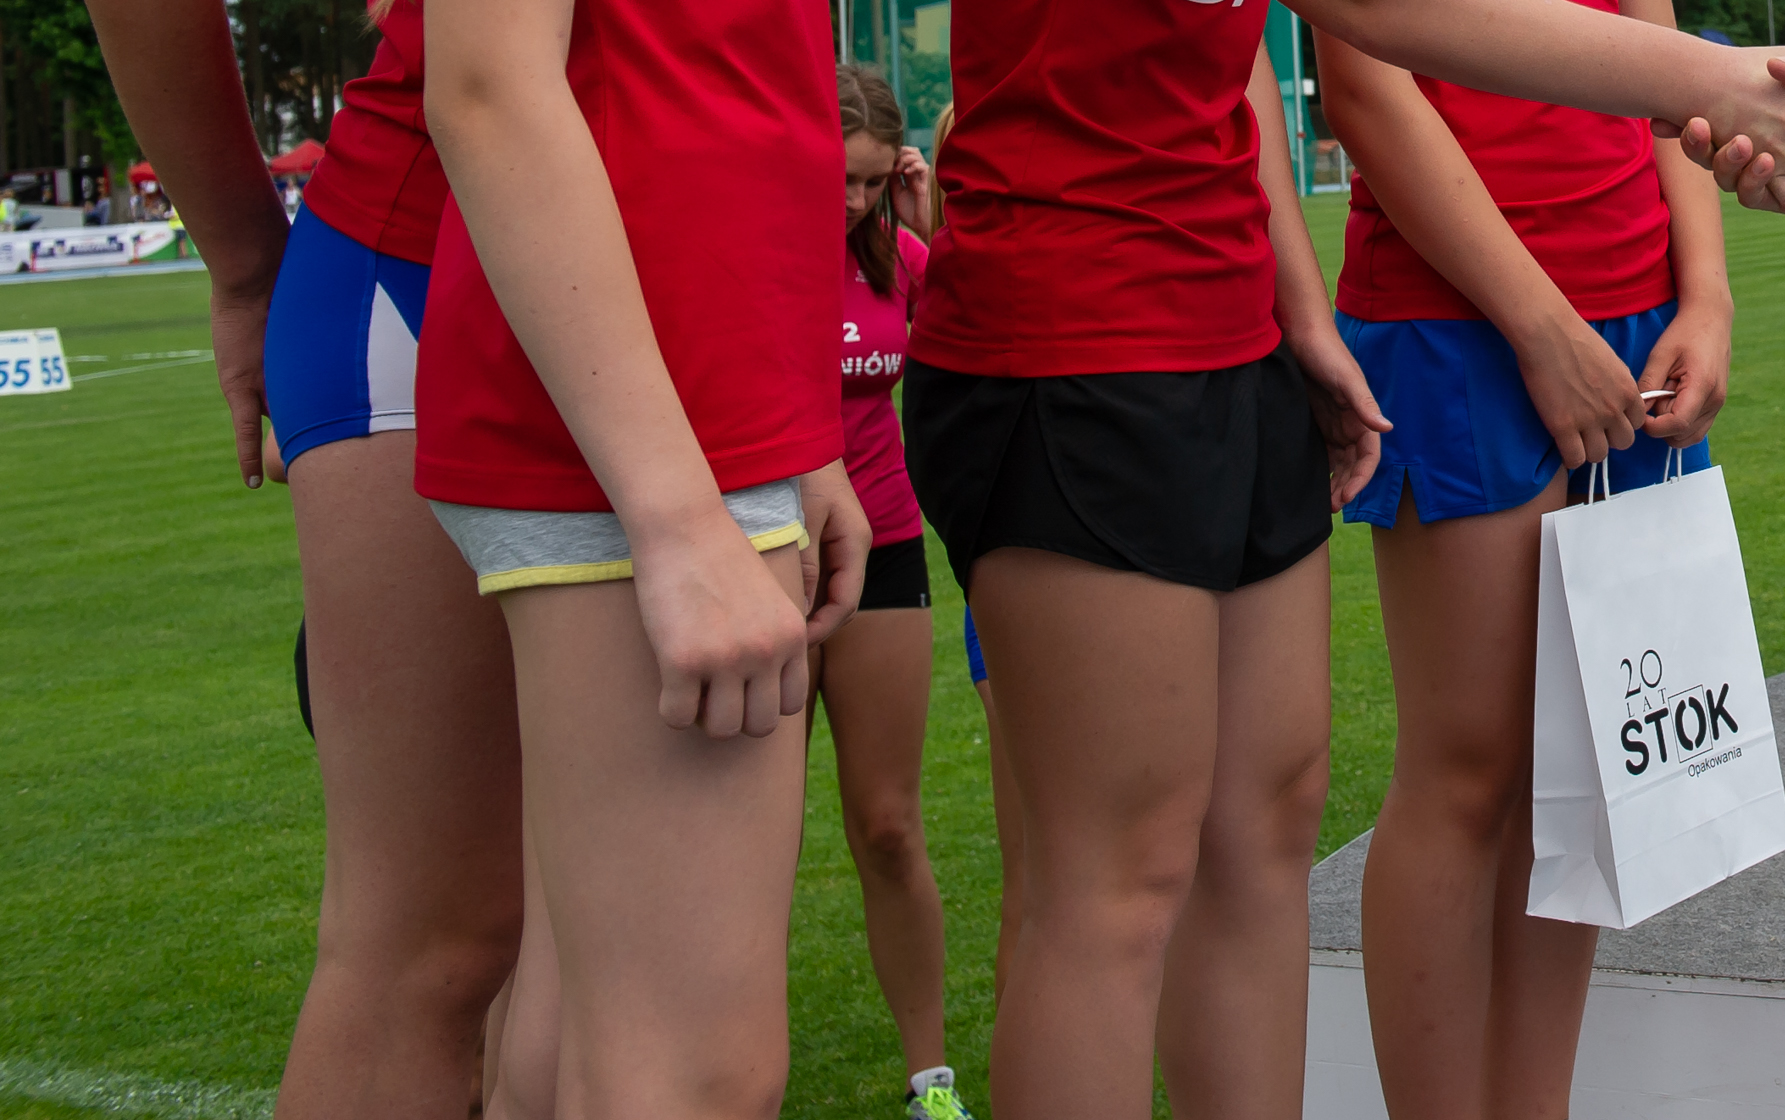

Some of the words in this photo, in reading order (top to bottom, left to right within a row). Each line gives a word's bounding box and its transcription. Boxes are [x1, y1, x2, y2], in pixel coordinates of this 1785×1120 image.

[842, 321, 861, 343] 2
[40, 356, 64, 386] 55
[1619, 648, 1663, 700] 20
[1626, 687, 1668, 719] LAT
[1620, 682, 1739, 776] STOK
[1687, 746, 1743, 778] Opakowania
